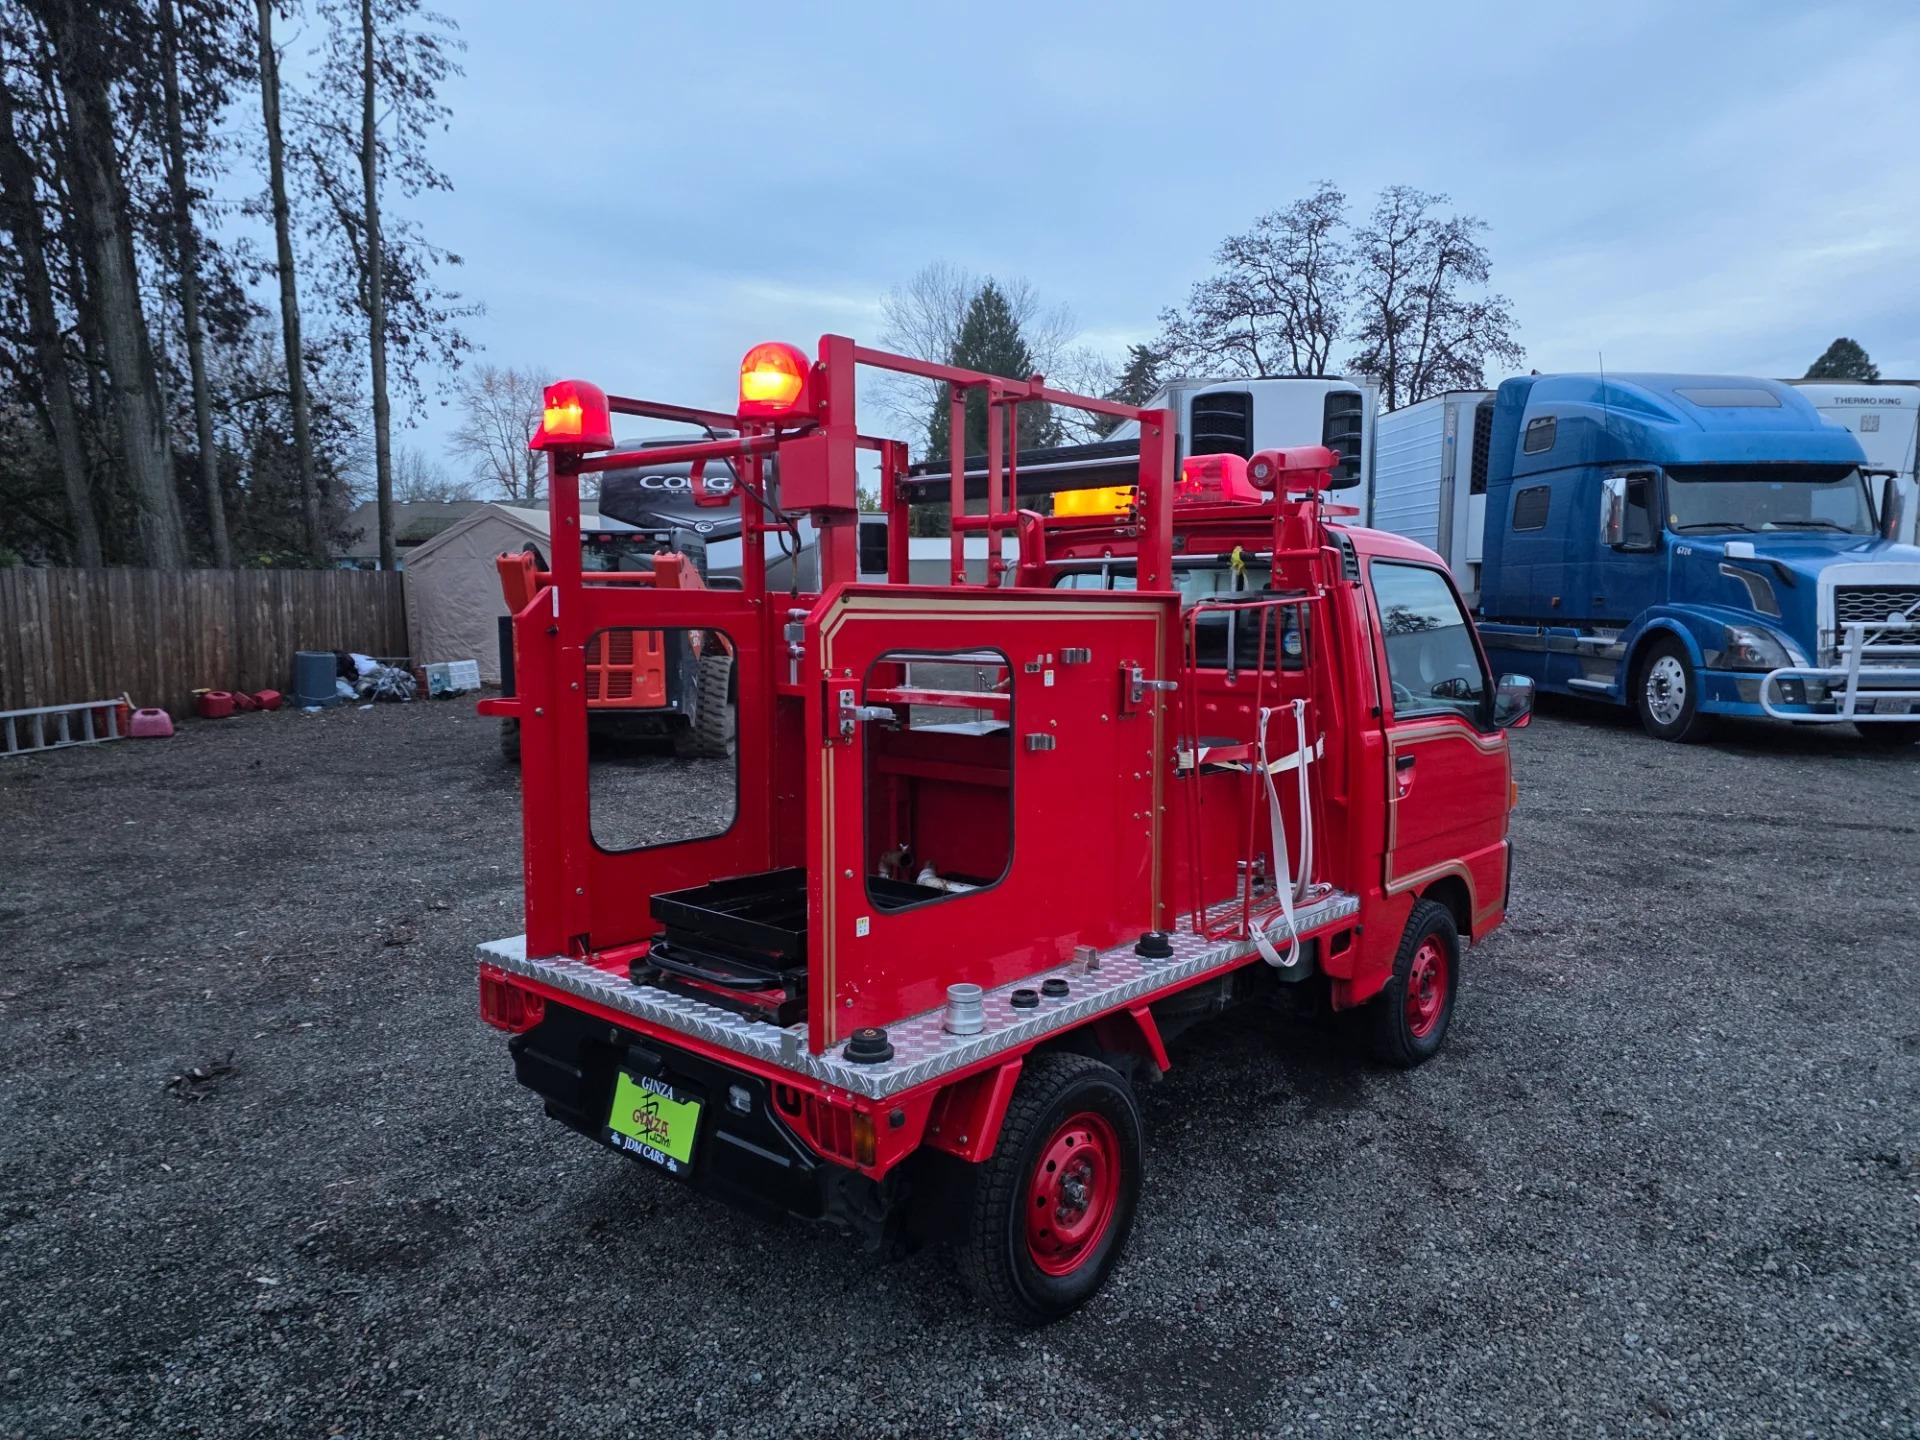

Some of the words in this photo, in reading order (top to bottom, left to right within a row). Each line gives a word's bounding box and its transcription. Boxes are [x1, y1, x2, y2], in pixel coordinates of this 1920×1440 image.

[1833, 397, 1877, 406] THERMO
[1878, 398, 1902, 406] KING
[641, 1076, 673, 1100] GINZA
[632, 1109, 669, 1137] GINZA
[622, 1136, 643, 1154] JDM
[643, 1145, 665, 1165] CARS
